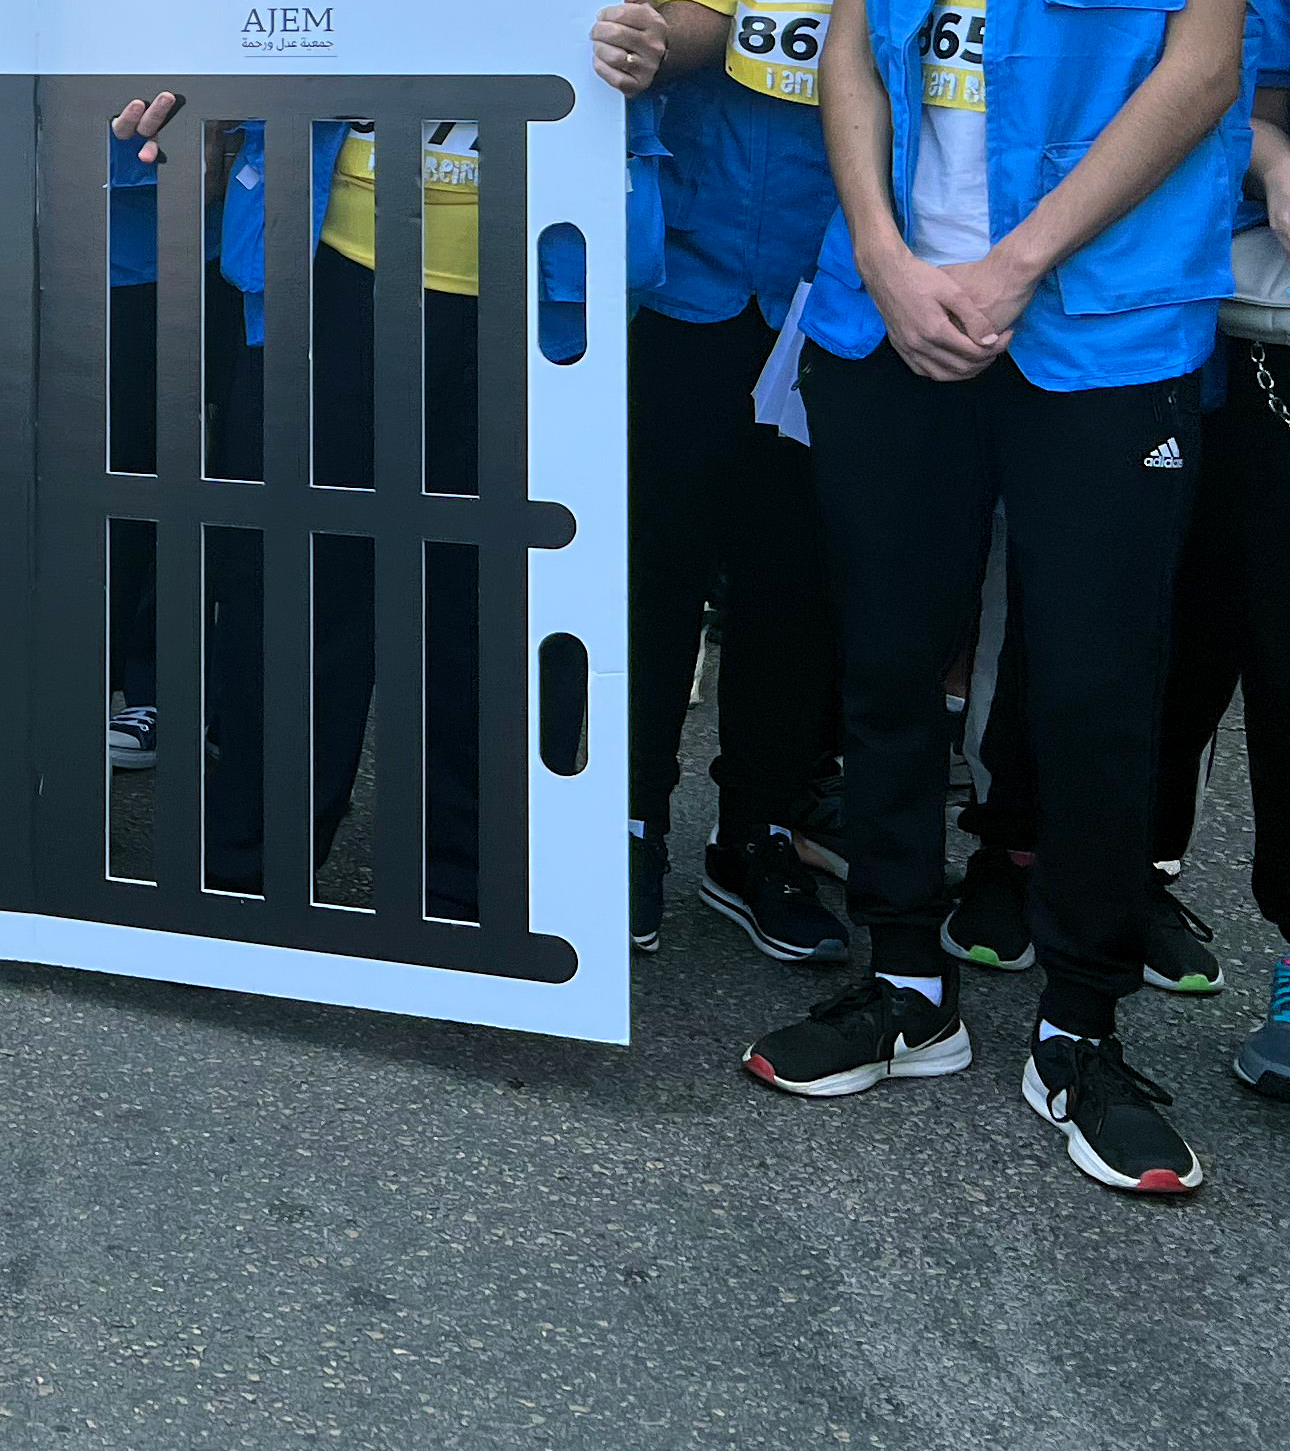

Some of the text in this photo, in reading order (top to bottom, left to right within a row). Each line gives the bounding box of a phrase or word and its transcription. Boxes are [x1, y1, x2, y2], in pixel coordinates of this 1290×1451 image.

[241, 7, 335, 38] AJEM
[738, 15, 821, 61] 86
[241, 37, 335, 51] جمعية عدل ورحمة
